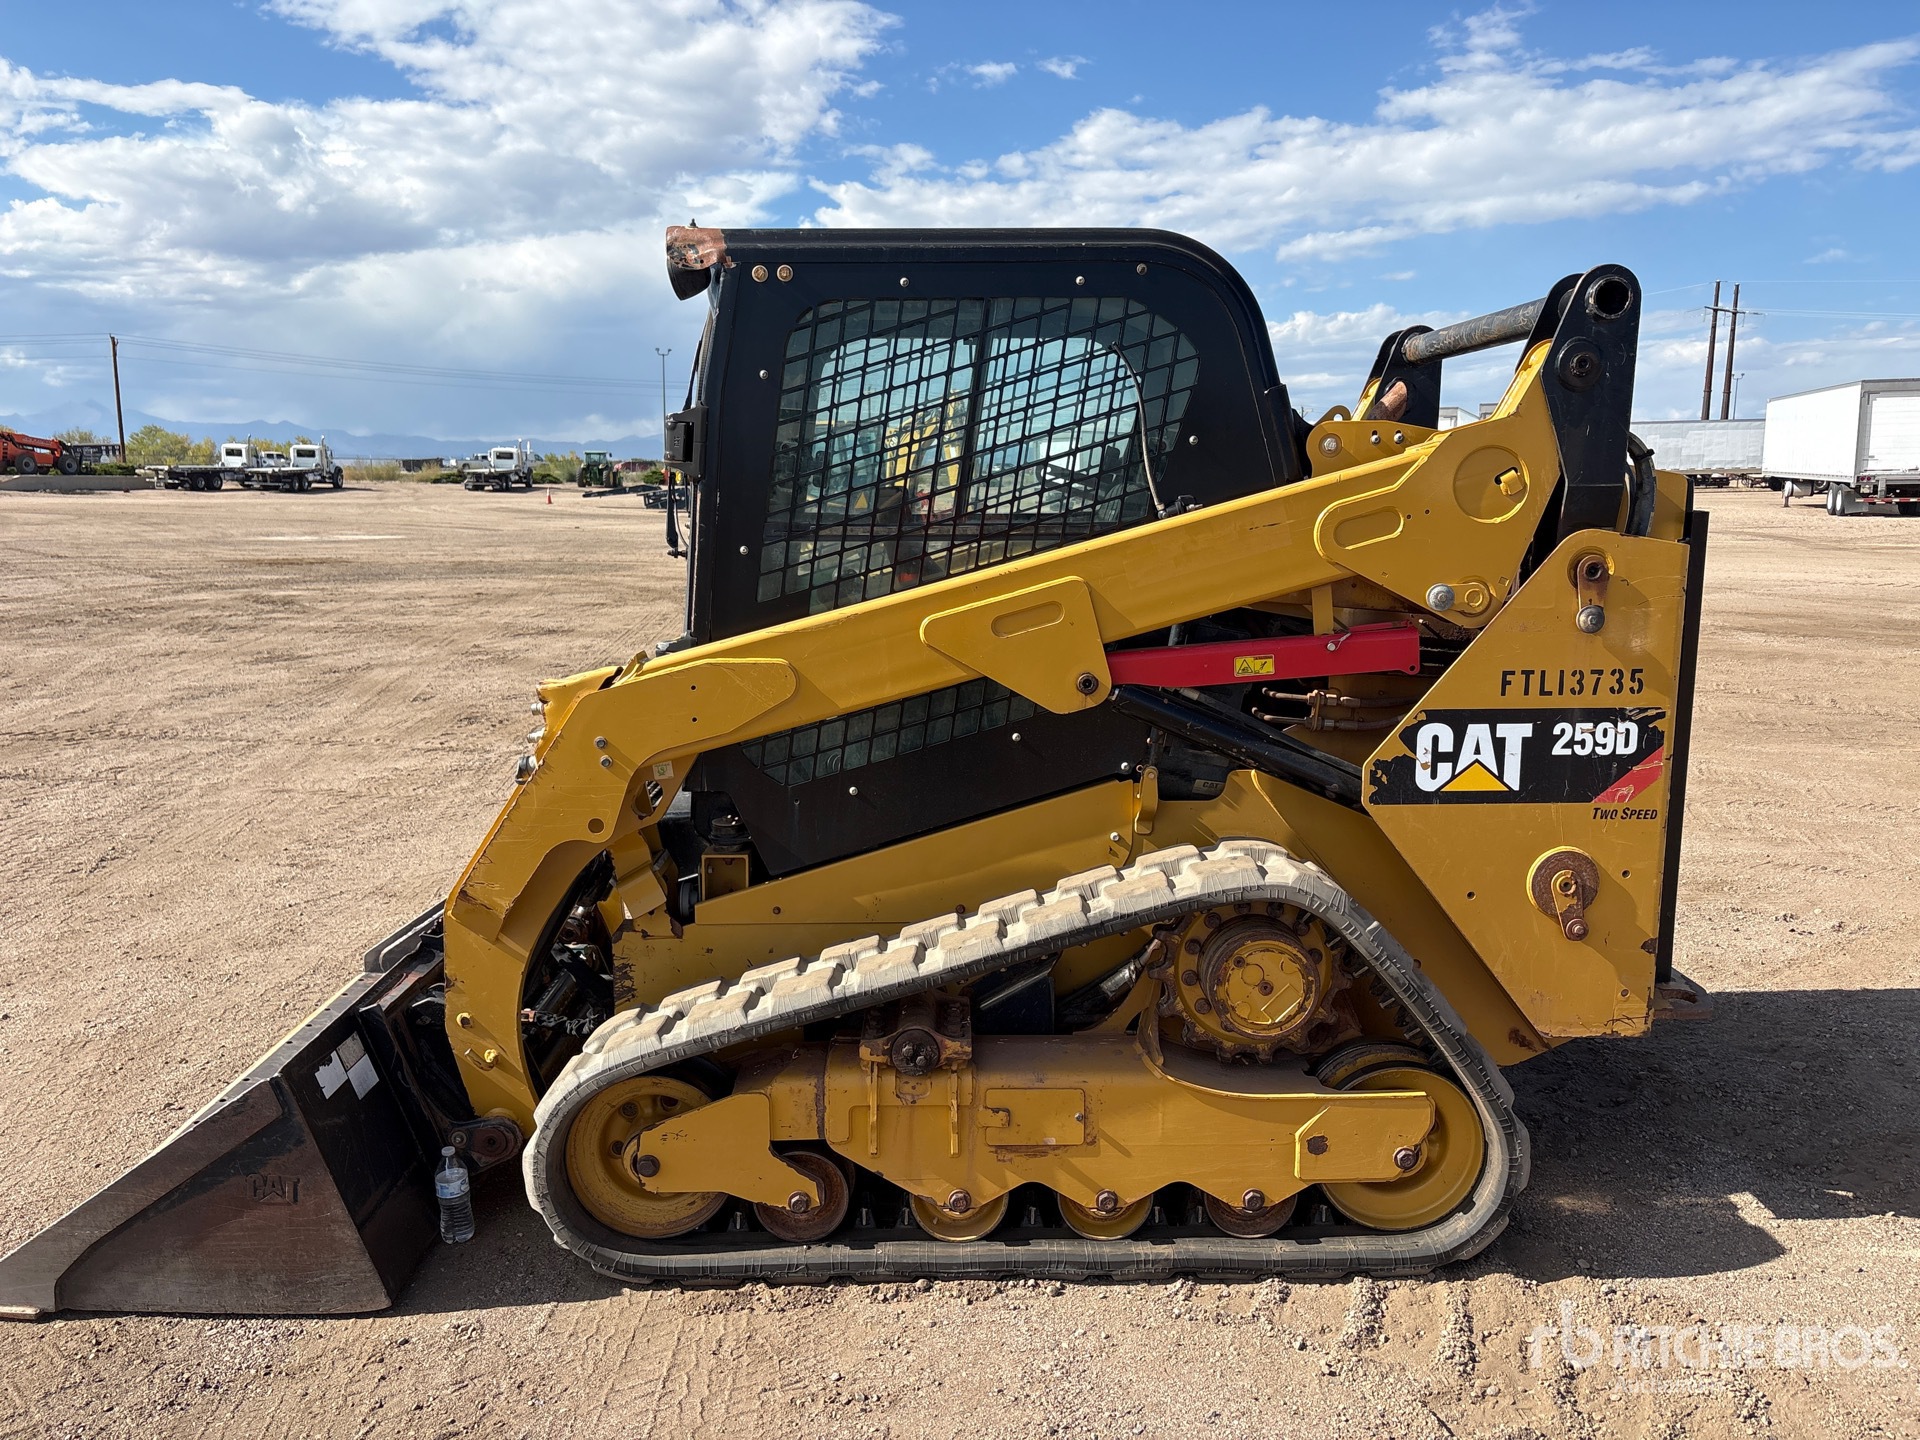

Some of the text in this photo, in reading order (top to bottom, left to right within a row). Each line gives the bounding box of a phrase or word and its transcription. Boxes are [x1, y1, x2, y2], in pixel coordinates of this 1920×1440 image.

[1414, 722, 1640, 793] CAT 259D
[245, 1172, 300, 1204] CAT
